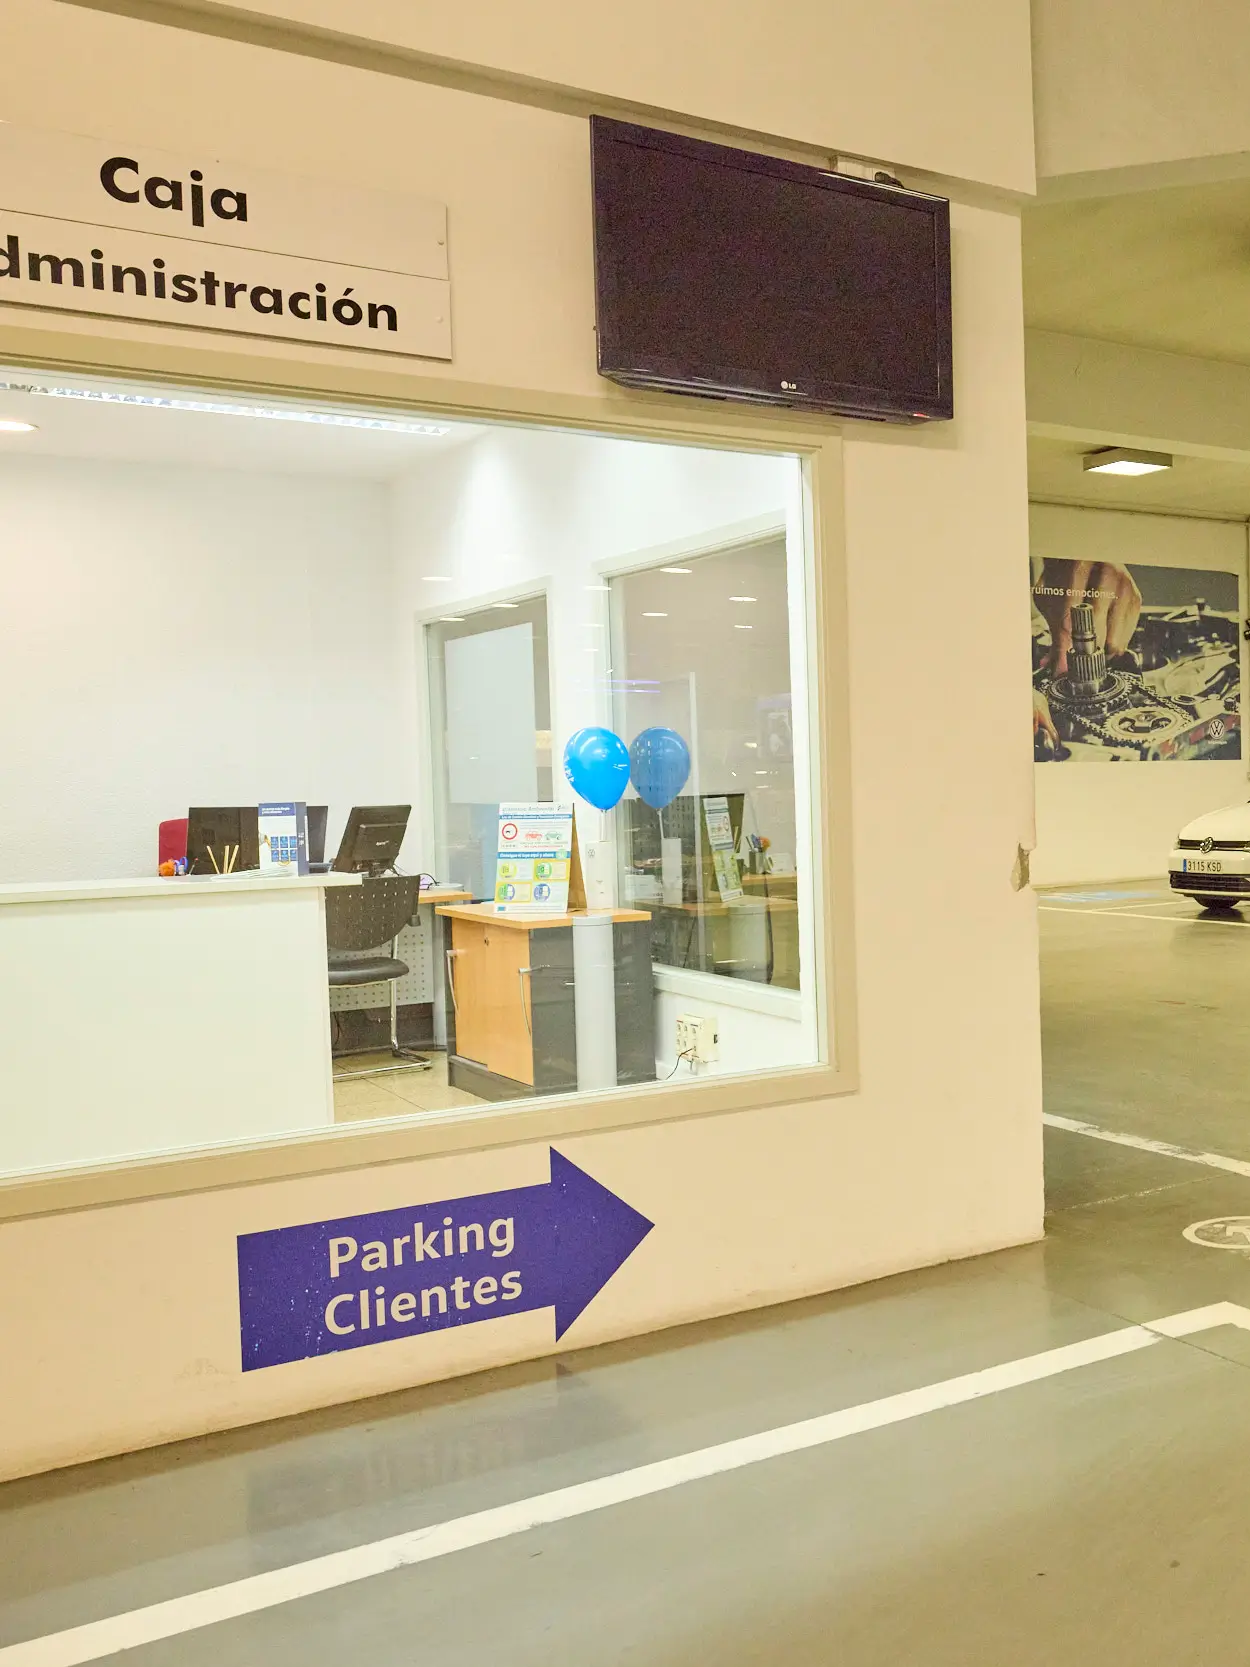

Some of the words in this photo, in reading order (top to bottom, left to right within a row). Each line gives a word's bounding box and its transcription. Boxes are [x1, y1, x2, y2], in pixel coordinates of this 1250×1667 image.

[99, 156, 248, 227] Caja
[1066, 588, 1119, 599] emociones.
[1187, 861, 1205, 871] 3115
[1206, 862, 1222, 872] KSD
[327, 1216, 515, 1278] Parking
[324, 1270, 523, 1337] Clientes
